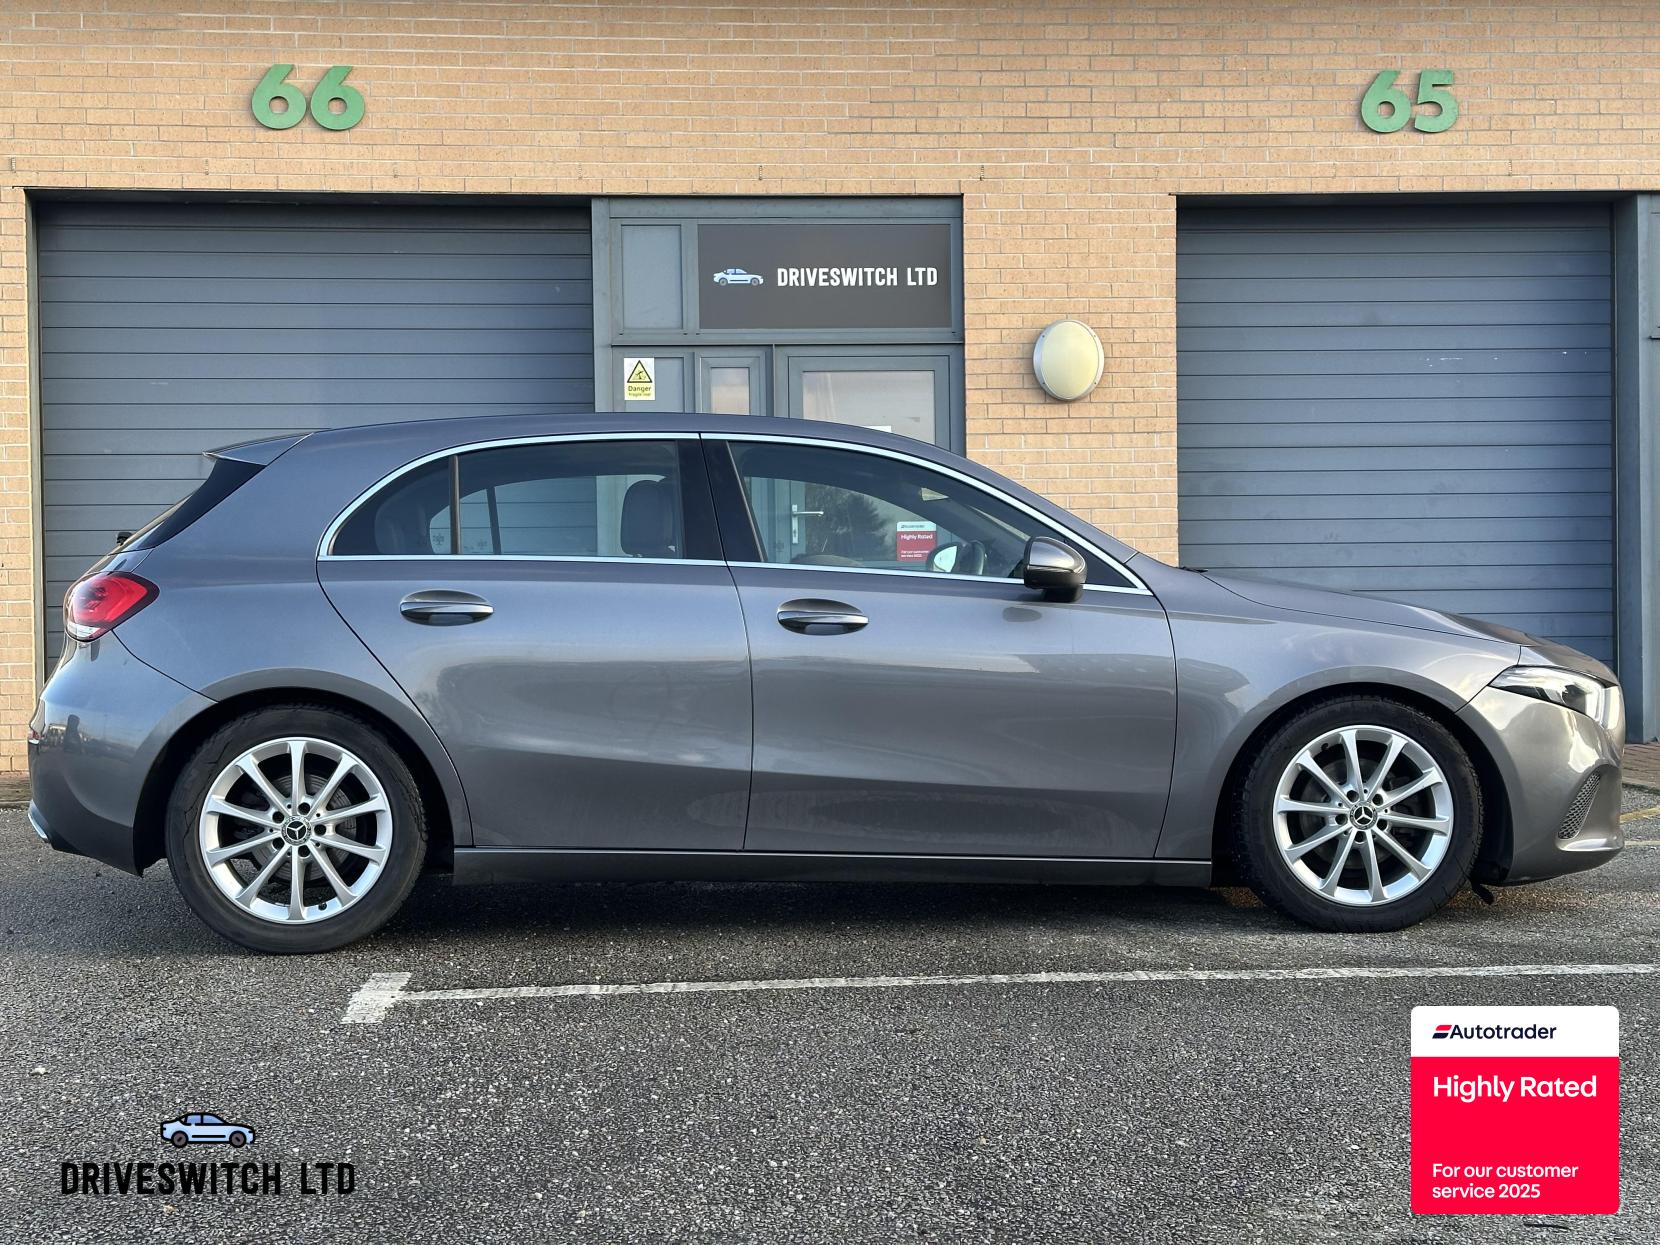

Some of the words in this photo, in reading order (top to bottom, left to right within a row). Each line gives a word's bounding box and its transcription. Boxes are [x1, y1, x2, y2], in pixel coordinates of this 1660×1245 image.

[251, 63, 366, 131] 66
[1360, 69, 1460, 133] 65
[777, 267, 898, 287] DRIVESWITCH
[906, 267, 938, 286] LTD
